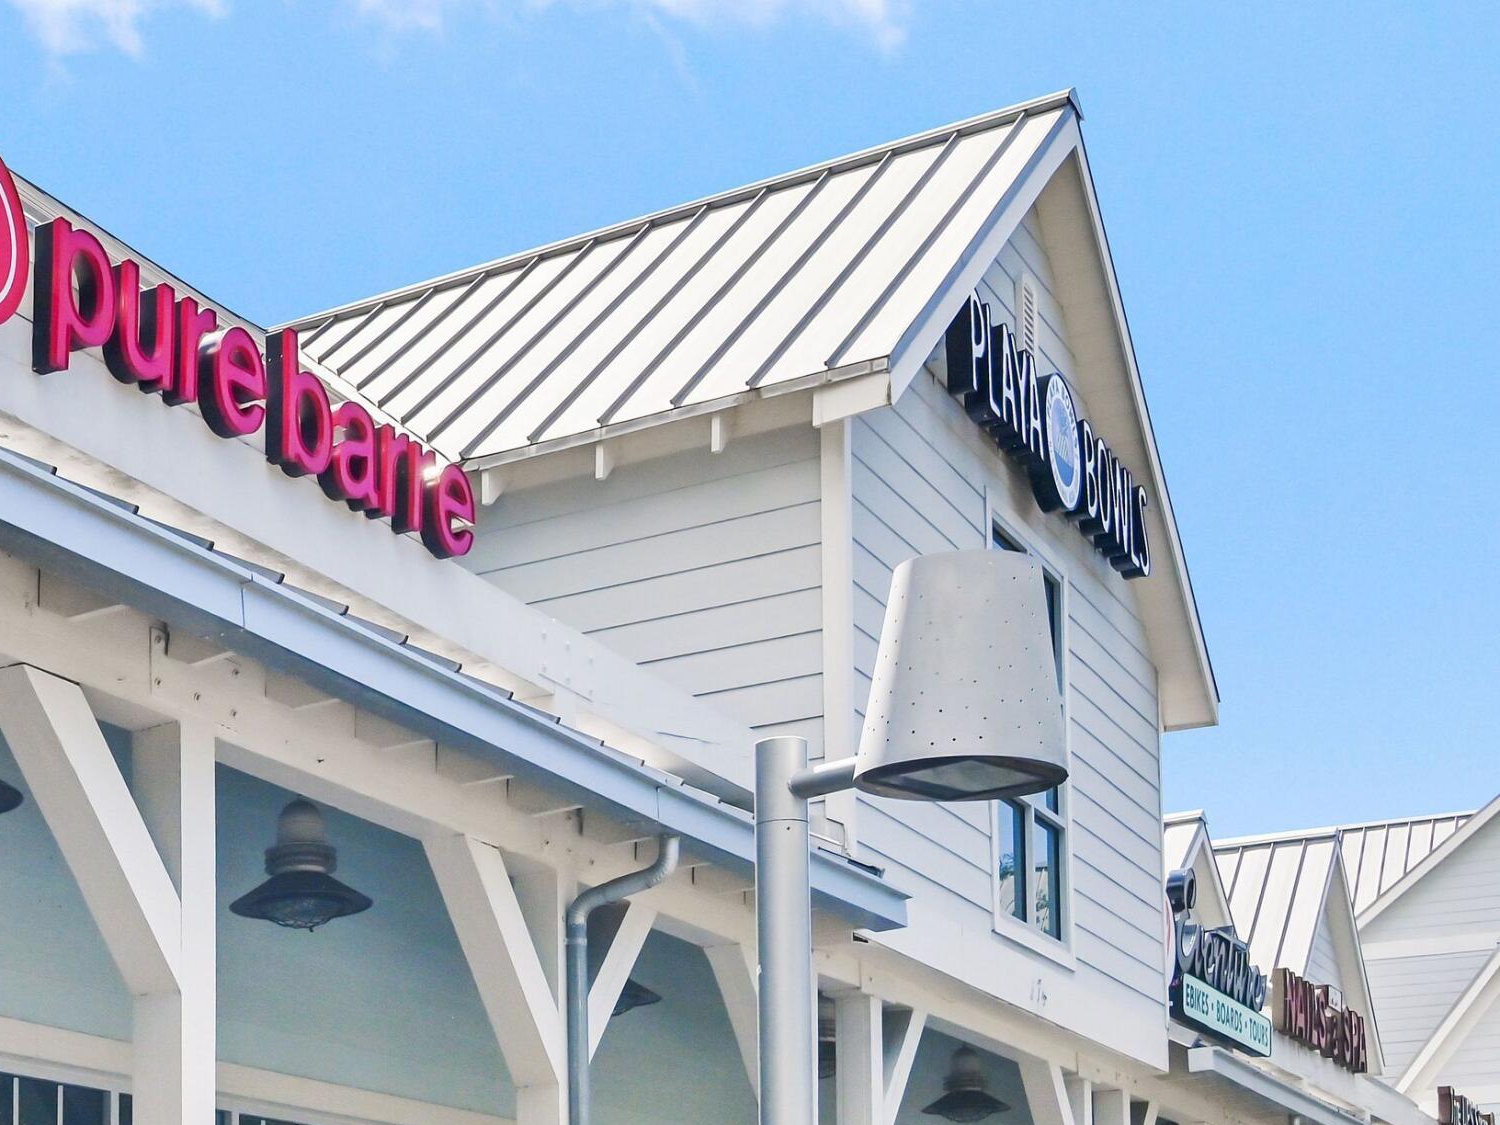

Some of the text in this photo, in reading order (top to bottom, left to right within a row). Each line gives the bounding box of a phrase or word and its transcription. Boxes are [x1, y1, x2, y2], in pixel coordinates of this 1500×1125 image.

[966, 288, 1150, 578] PLAYA BOWLS
[1185, 983, 1269, 1048] EBIKES BOARDS TOURS
[1282, 968, 1327, 1049] NAILS
[1343, 1007, 1368, 1073] SPA
